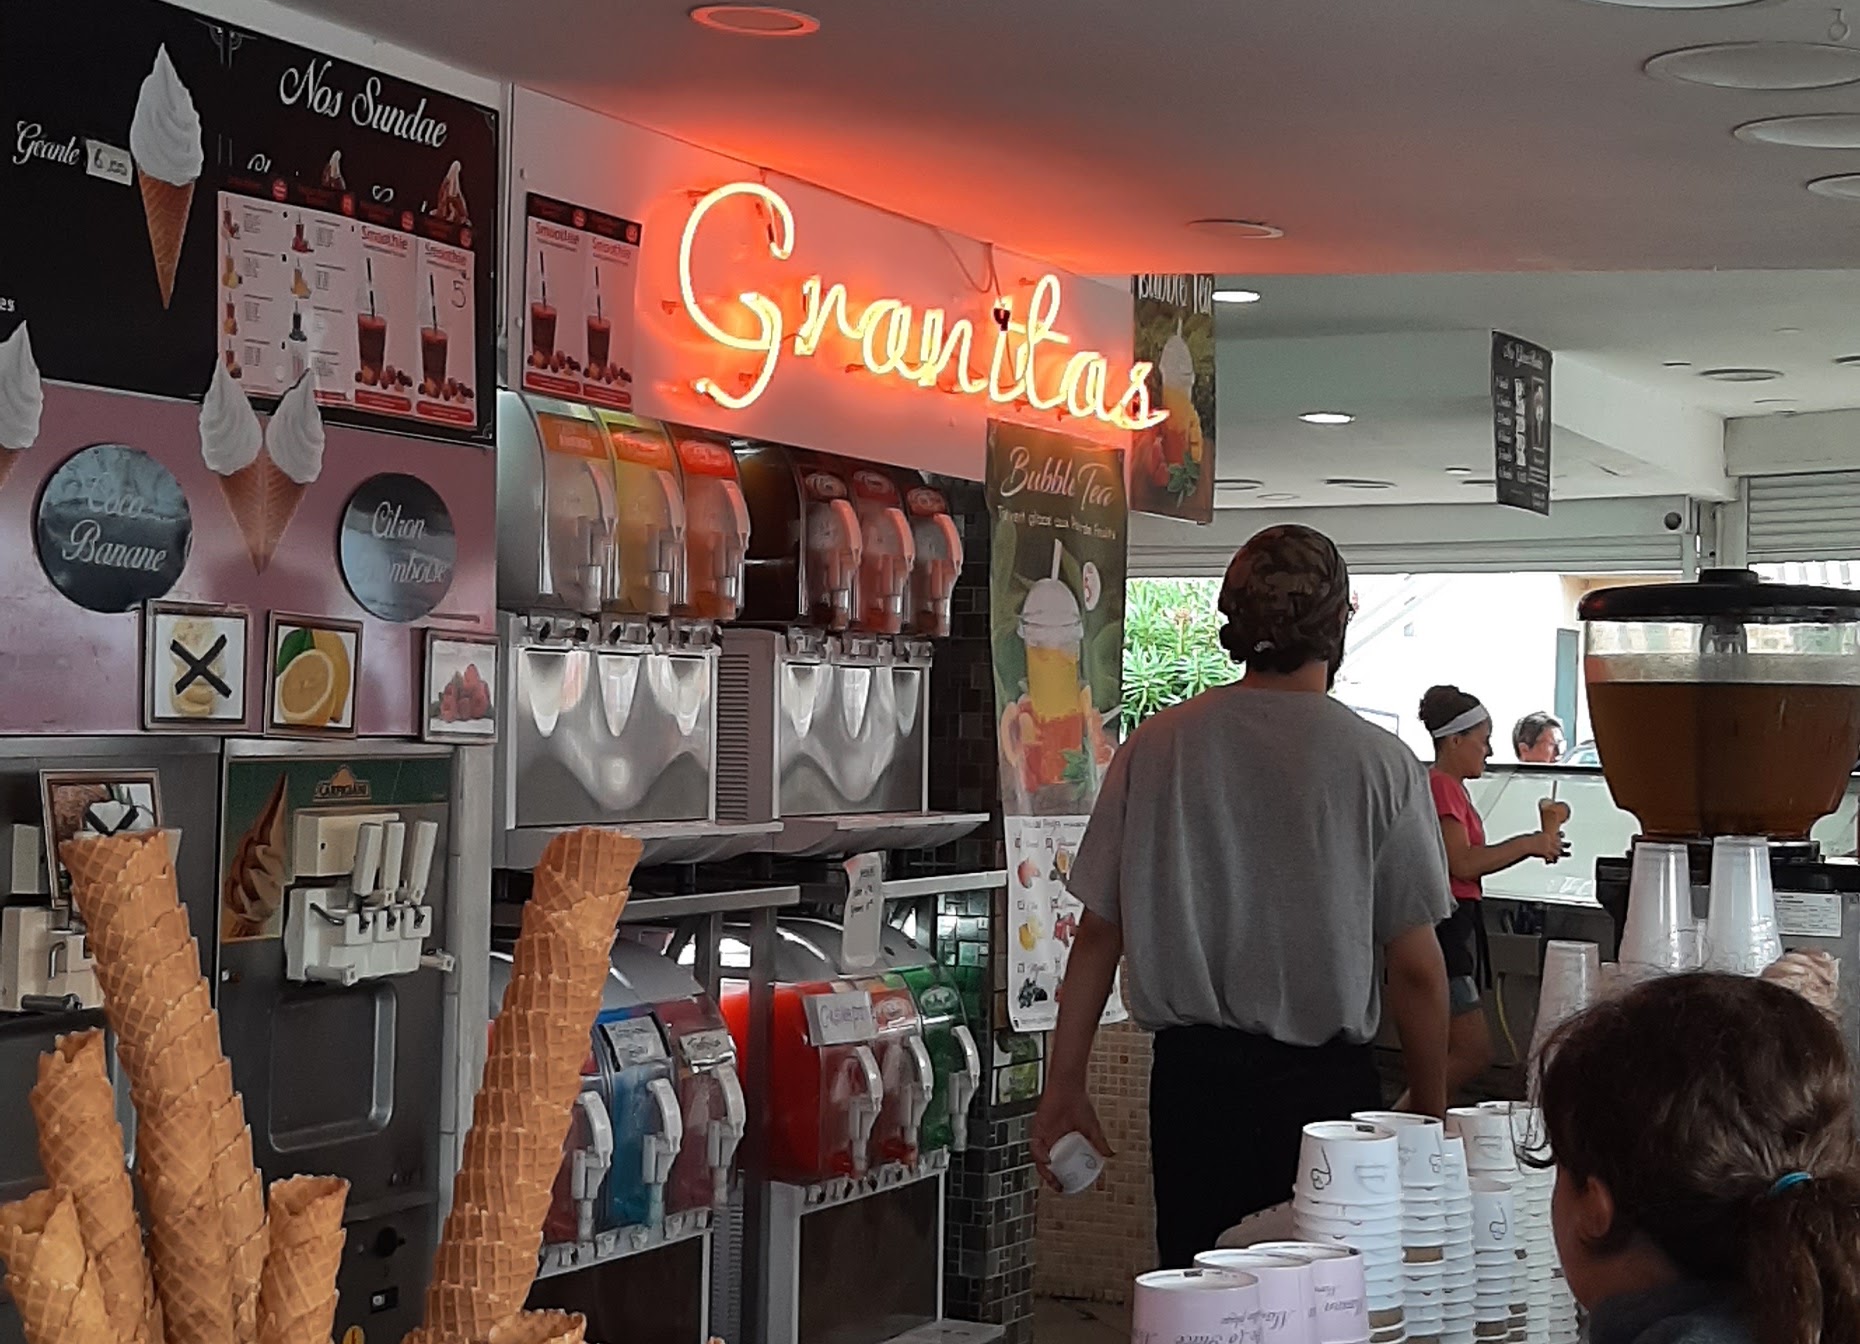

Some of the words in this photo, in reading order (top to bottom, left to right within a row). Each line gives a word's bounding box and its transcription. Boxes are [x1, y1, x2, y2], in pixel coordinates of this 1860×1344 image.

[279, 58, 343, 117] Nos
[352, 76, 449, 148] Sundae
[361, 225, 409, 250] Smoothie
[679, 181, 1171, 430] Granitas
[1000, 445, 1075, 498] Bubble
[1078, 462, 1114, 510] Tea
[61, 519, 168, 571] Banane
[371, 501, 426, 540] Citron
